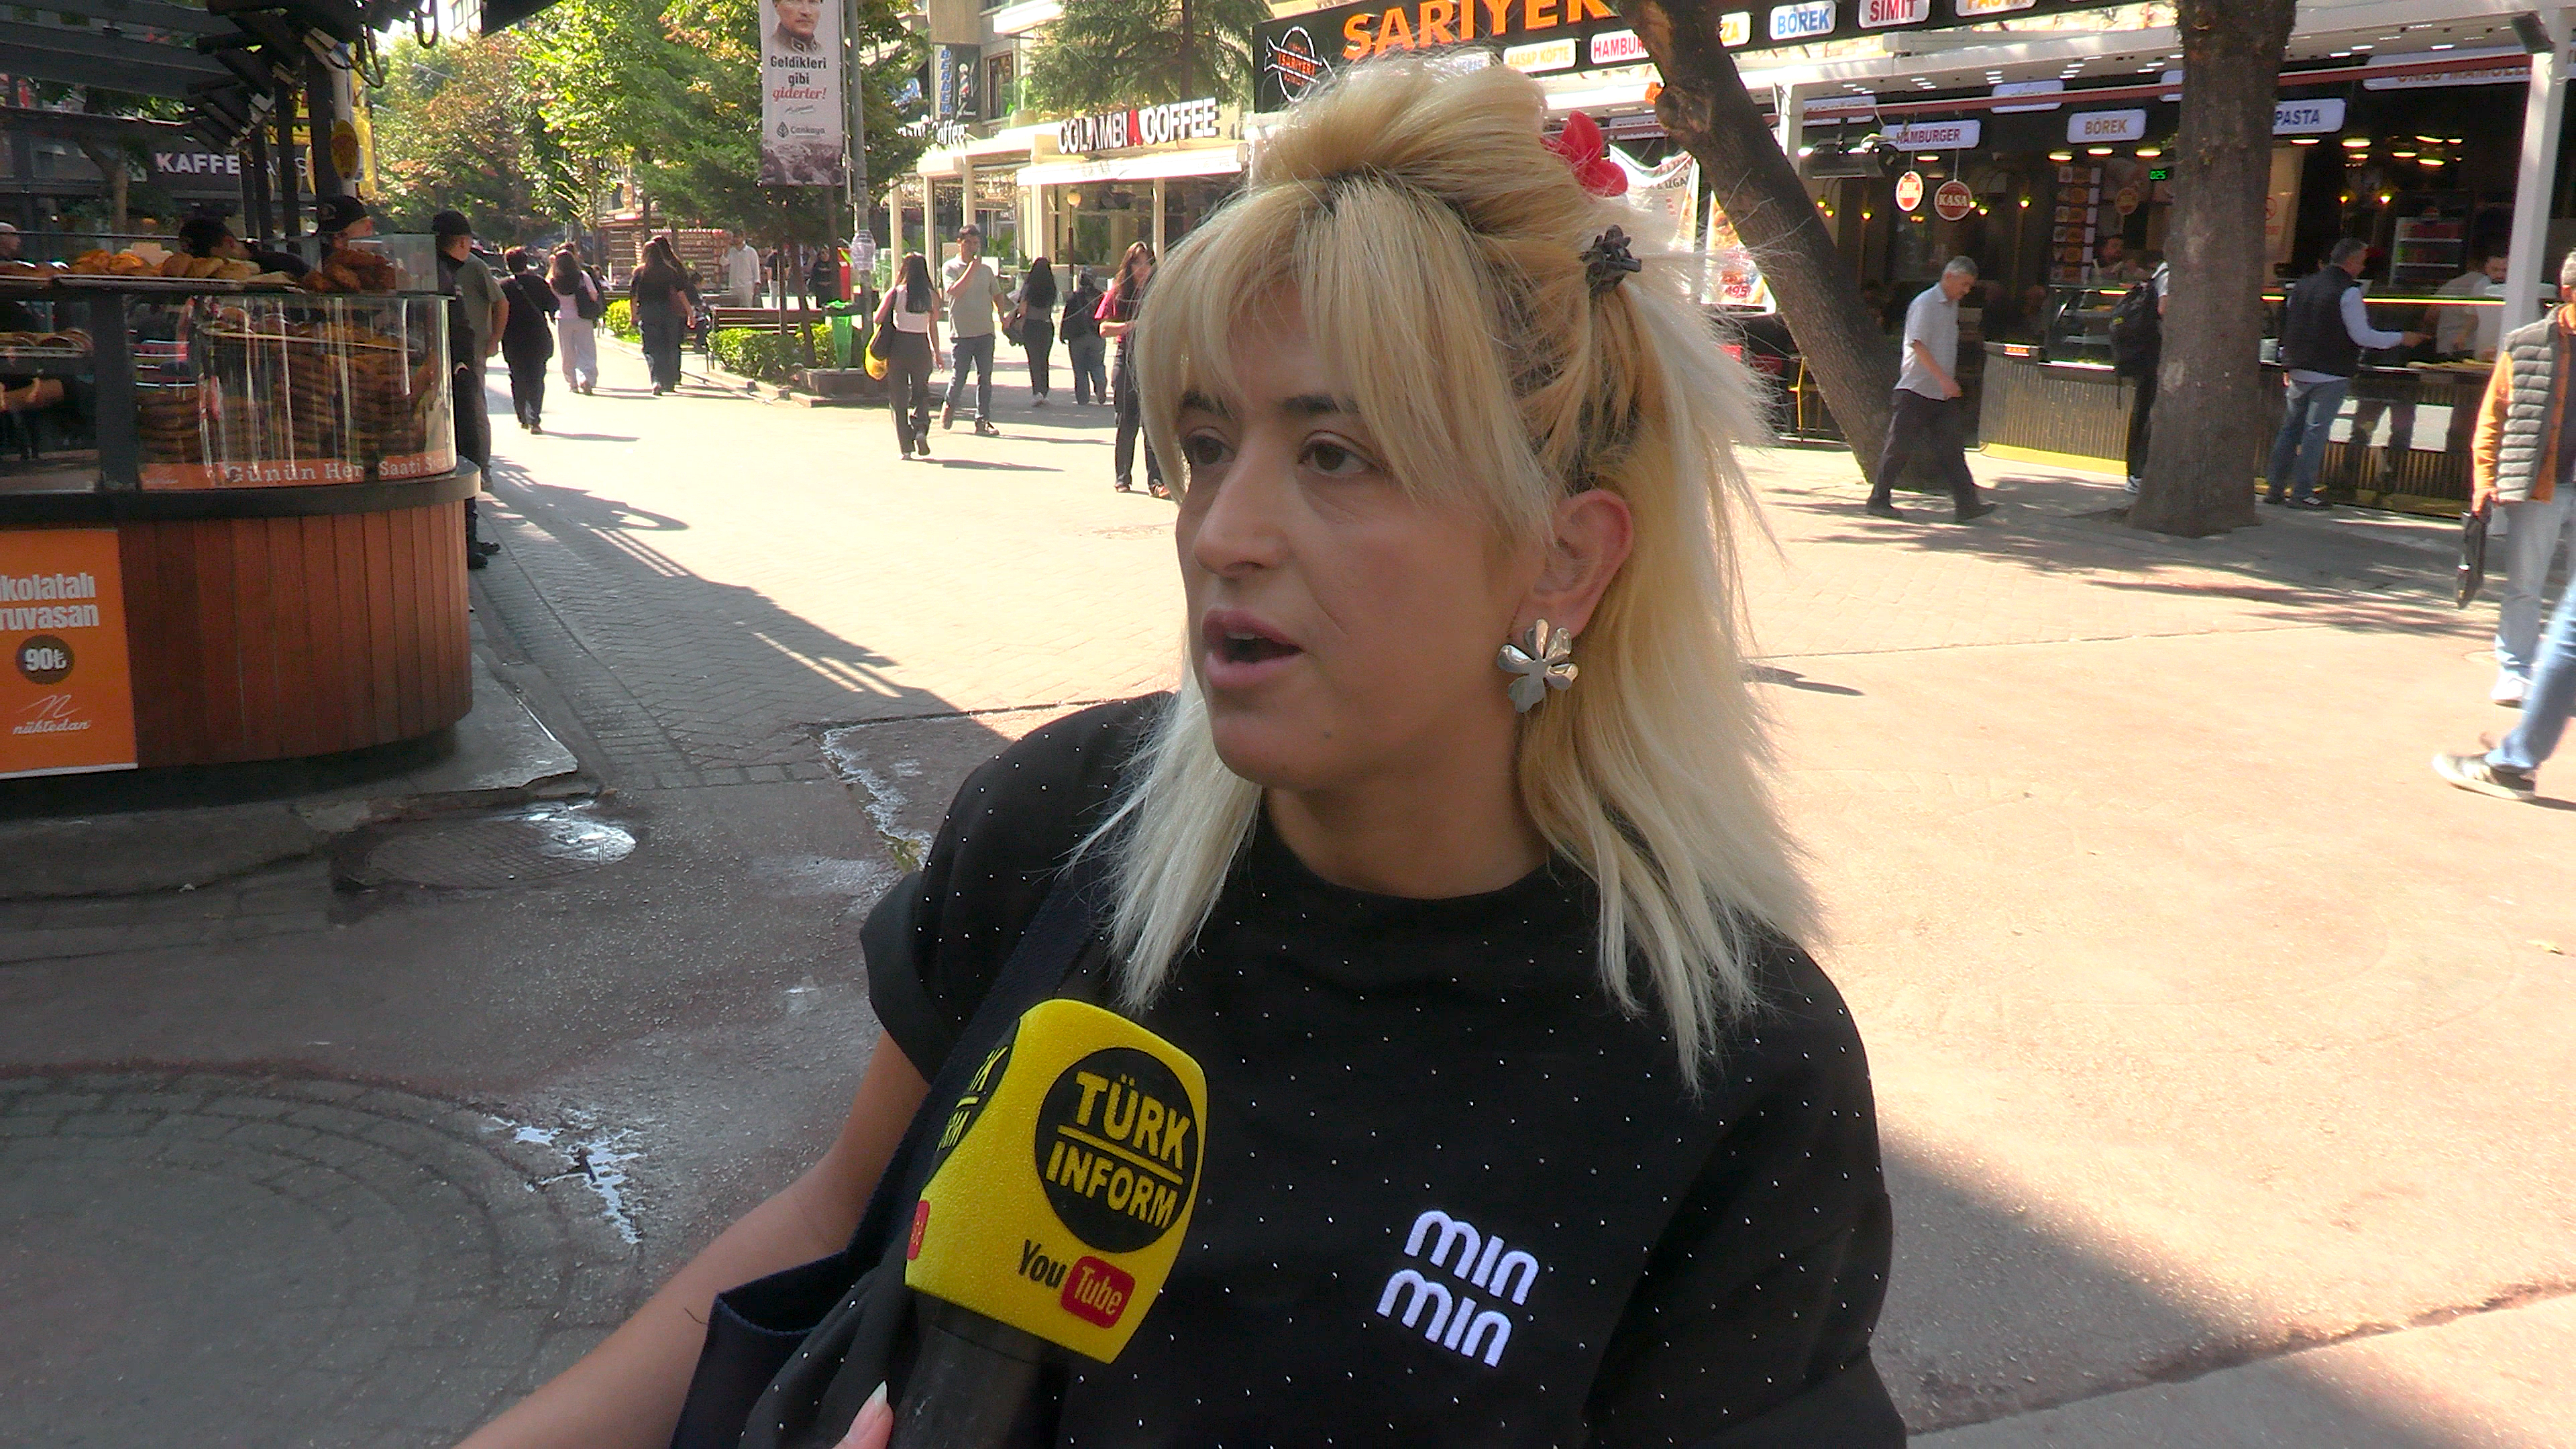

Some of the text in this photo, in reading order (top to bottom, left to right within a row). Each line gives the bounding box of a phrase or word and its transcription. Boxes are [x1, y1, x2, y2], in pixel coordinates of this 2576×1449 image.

[1777, 7, 1830, 35] BÖREK
[770, 55, 827, 68] Geldikleri
[1540, 46, 1570, 63] KÖFTE
[788, 72, 810, 87] gibi
[772, 87, 826, 102] giderler!
[1143, 97, 1217, 144] COFFEE
[2273, 109, 2320, 125] PASTA
[2084, 118, 2128, 135] BÖREK
[1896, 128, 1960, 144] HAMBURGER
[1939, 193, 1968, 207] KASA
[324, 462, 364, 480] Her
[378, 458, 421, 476] Saati
[0, 572, 96, 602] kolatalı
[1075, 1071, 1191, 1171] TÜRK
[1045, 1141, 1179, 1229] INFORM
